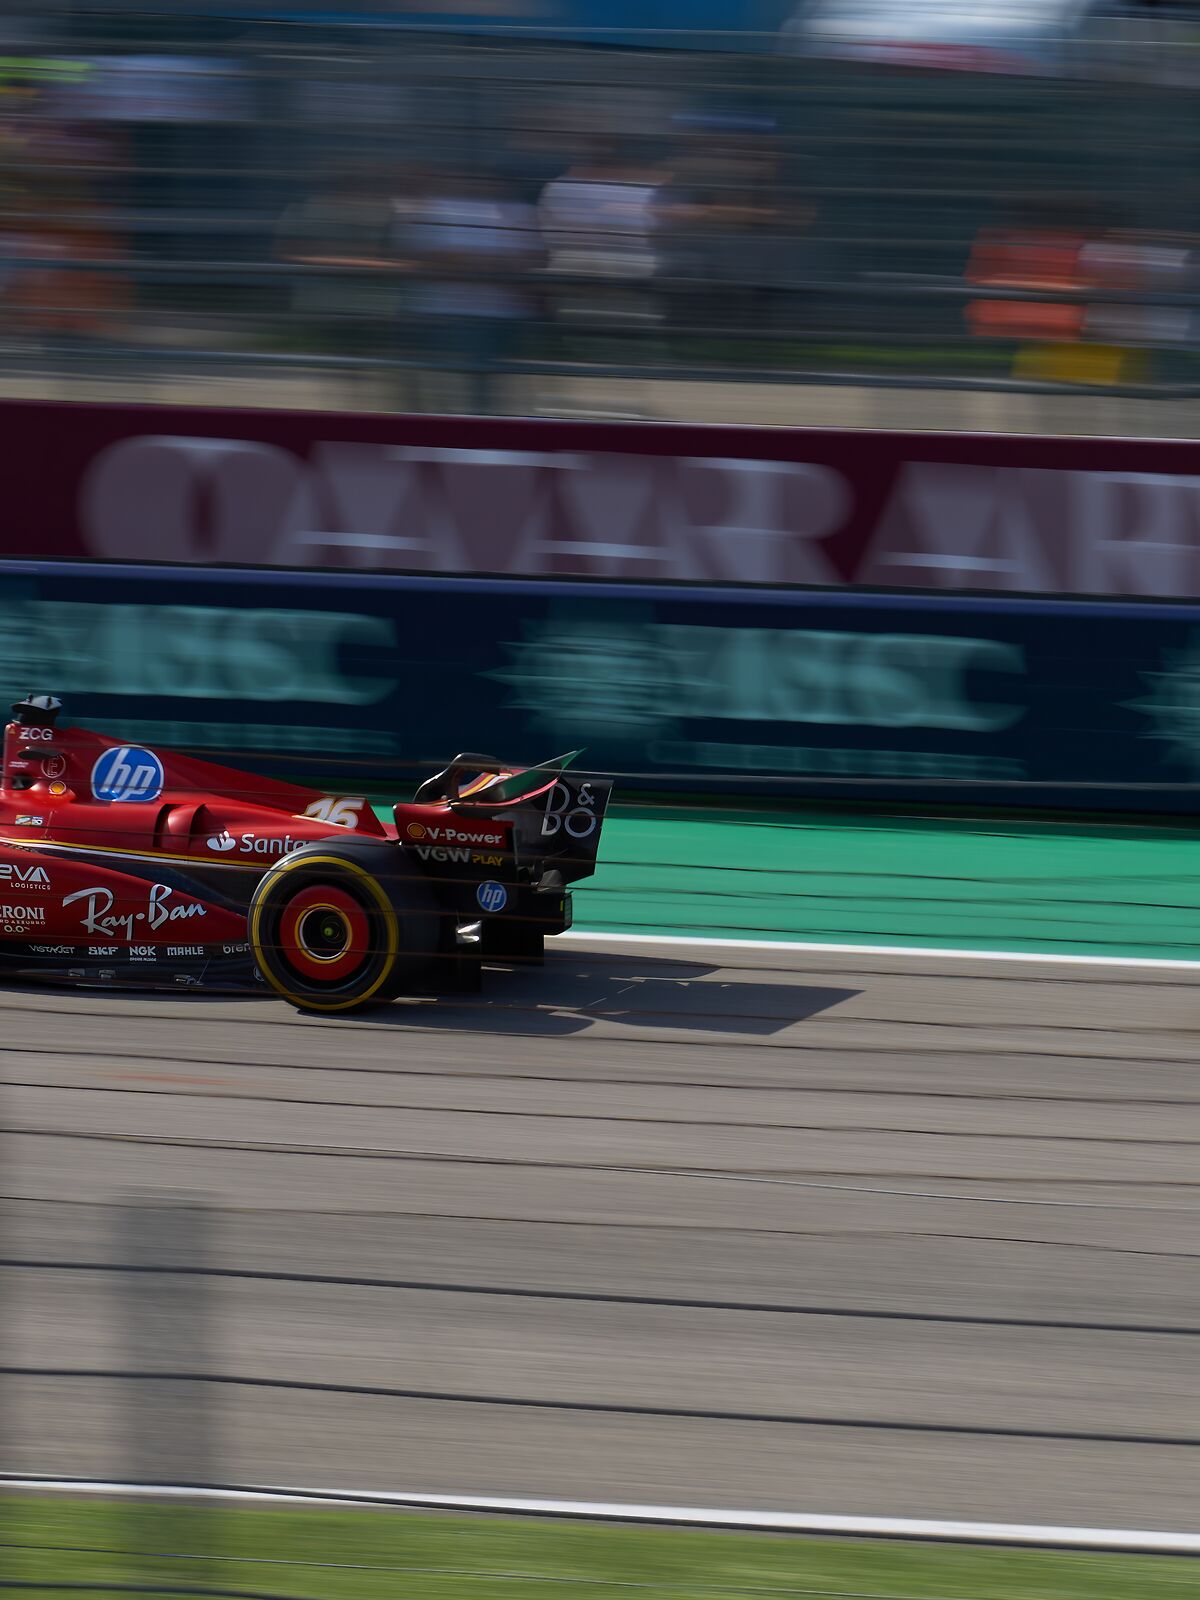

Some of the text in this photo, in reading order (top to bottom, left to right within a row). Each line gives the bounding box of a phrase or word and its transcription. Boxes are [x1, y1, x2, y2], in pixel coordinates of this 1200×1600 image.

[19, 727, 54, 741] ZCG
[99, 747, 157, 802] hp
[302, 796, 366, 830] 16
[426, 827, 502, 844] V-Power
[415, 845, 503, 867] VGW PLAY
[10, 882, 51, 890] LOGISTICS
[480, 882, 502, 912] hp
[88, 946, 119, 955] SKF
[129, 946, 156, 956] NGK
[167, 946, 204, 956] MAHLE
